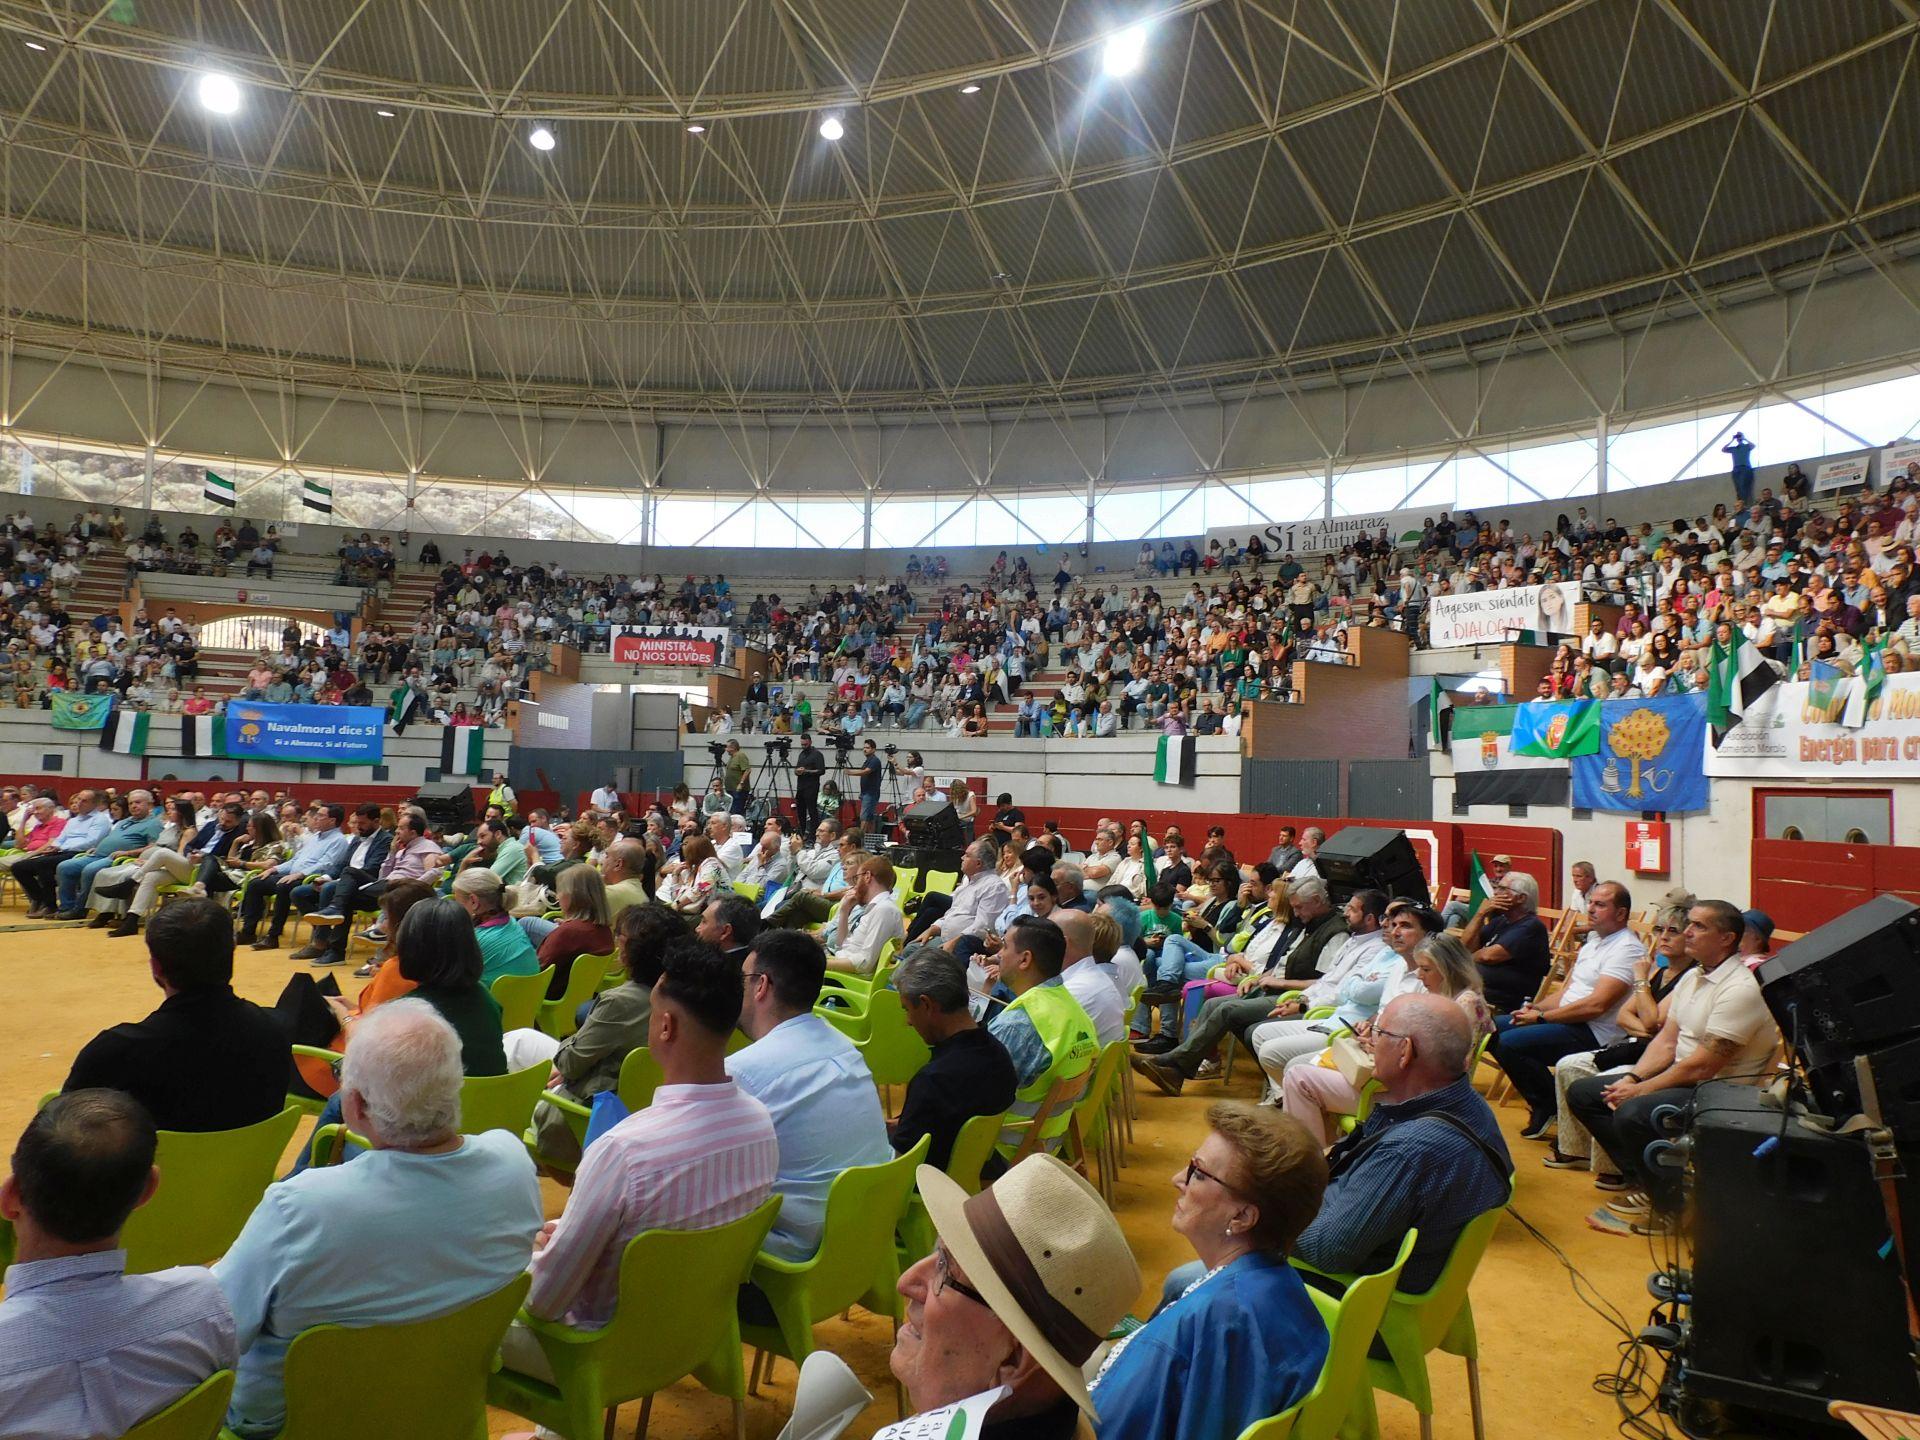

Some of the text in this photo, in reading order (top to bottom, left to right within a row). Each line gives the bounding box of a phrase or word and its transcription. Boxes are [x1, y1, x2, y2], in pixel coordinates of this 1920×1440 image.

[1264, 517, 1389, 553] Sí a Almaraz,
[1302, 535, 1317, 550] al
[1435, 589, 1536, 622] Aagesen siéntate
[1442, 629, 1449, 640] a
[639, 640, 697, 652] MINISTRA,
[623, 649, 639, 661] NO
[642, 652, 665, 661] NOS
[267, 722, 336, 735] Navalmoral
[338, 724, 363, 736] dice
[342, 741, 368, 749] Futuro
[1798, 734, 1857, 765] Energía
[1860, 737, 1899, 764] para
